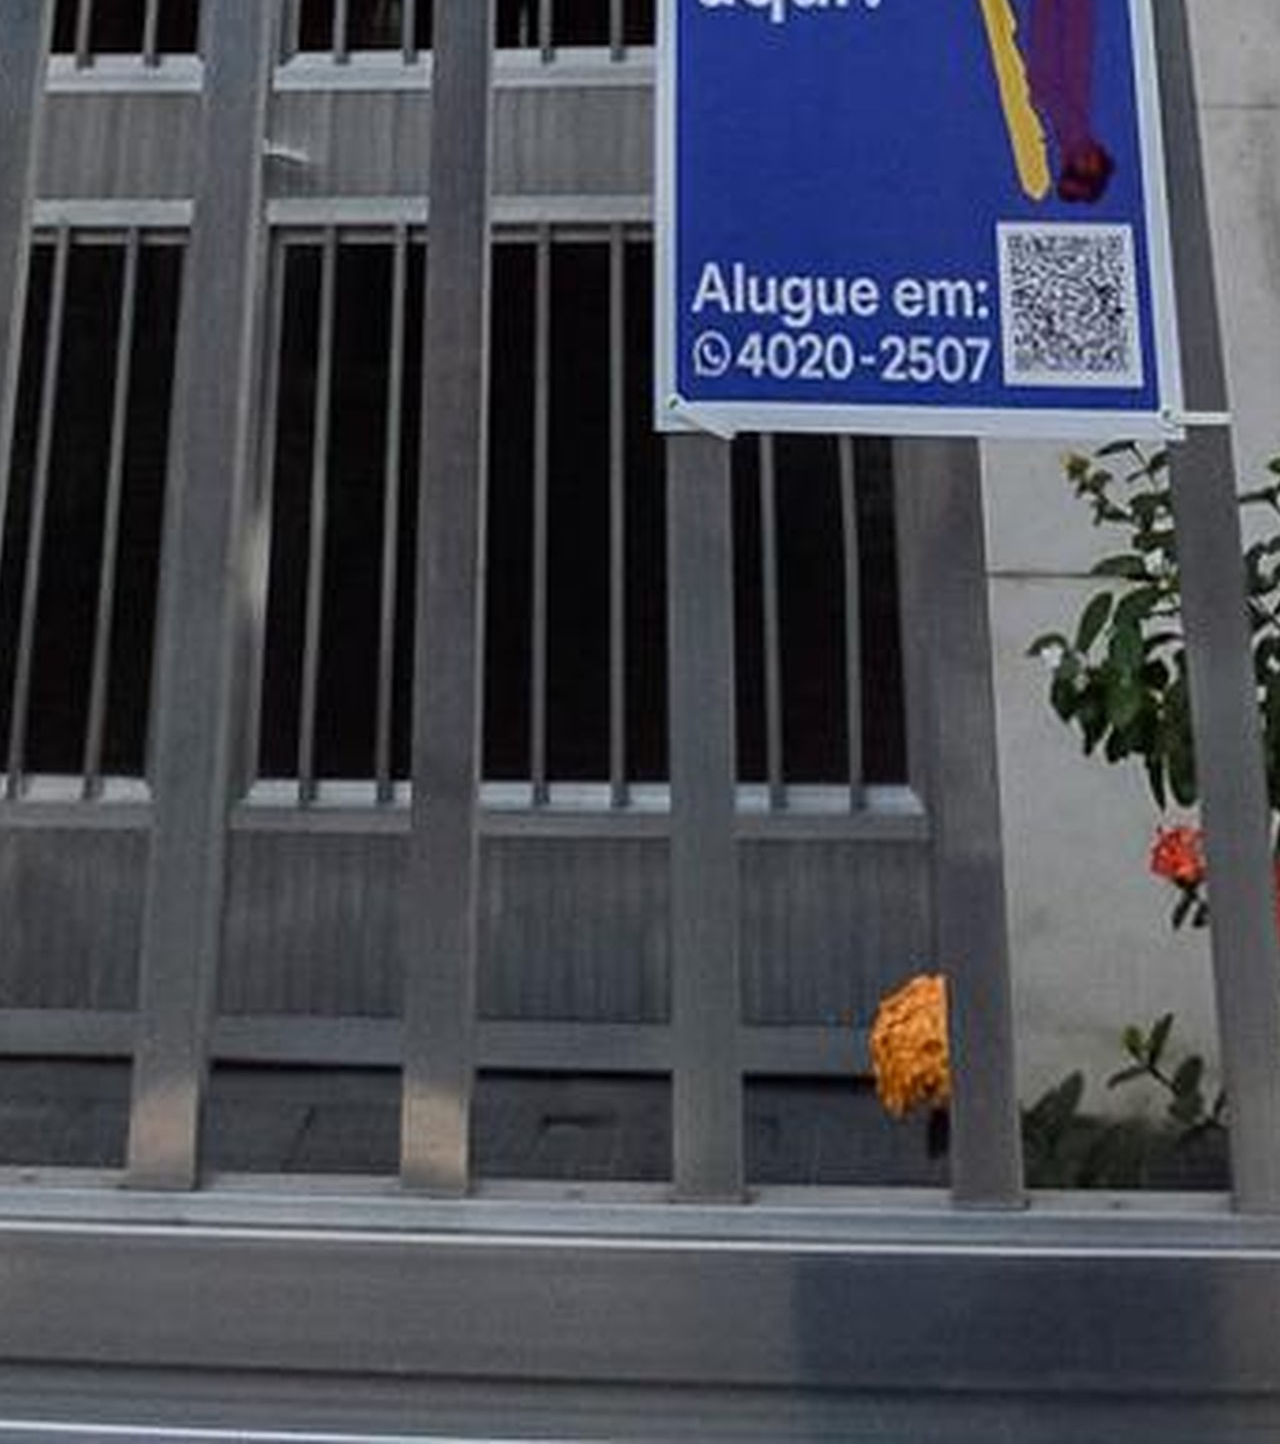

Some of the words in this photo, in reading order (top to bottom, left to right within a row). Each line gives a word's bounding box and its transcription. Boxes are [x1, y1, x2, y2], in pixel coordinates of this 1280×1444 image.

[691, 262, 880, 327] Alugue
[892, 275, 991, 319] em:
[736, 332, 990, 383] 4020-2507
